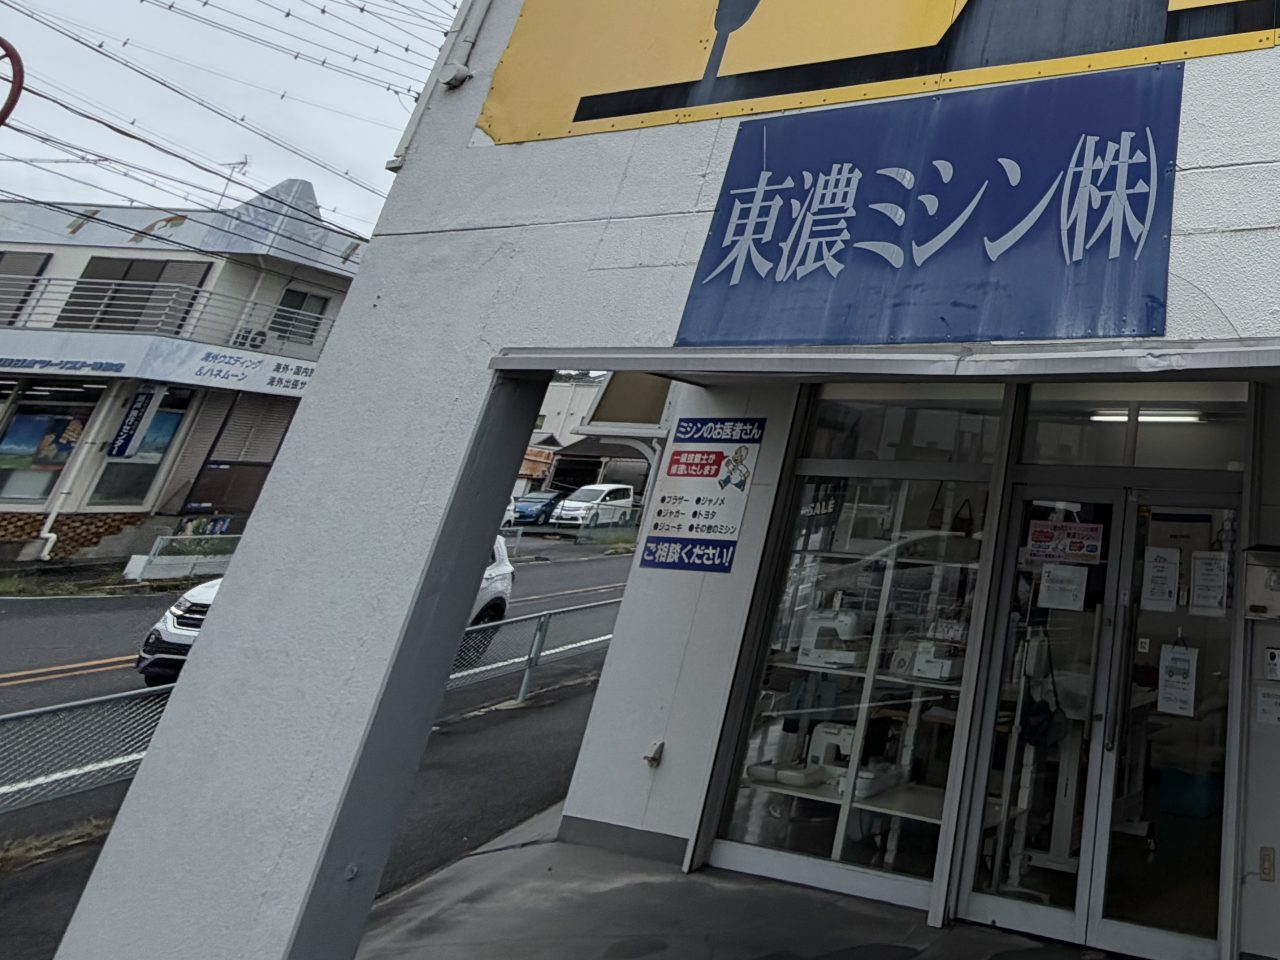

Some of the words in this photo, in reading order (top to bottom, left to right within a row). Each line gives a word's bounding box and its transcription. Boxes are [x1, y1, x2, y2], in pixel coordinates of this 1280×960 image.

[702, 126, 1158, 287] 東濃ミシン(株)
[676, 421, 762, 441] ミシンのお医者さん
[806, 499, 836, 517] SALE
[643, 542, 734, 567] ご相談ください!
